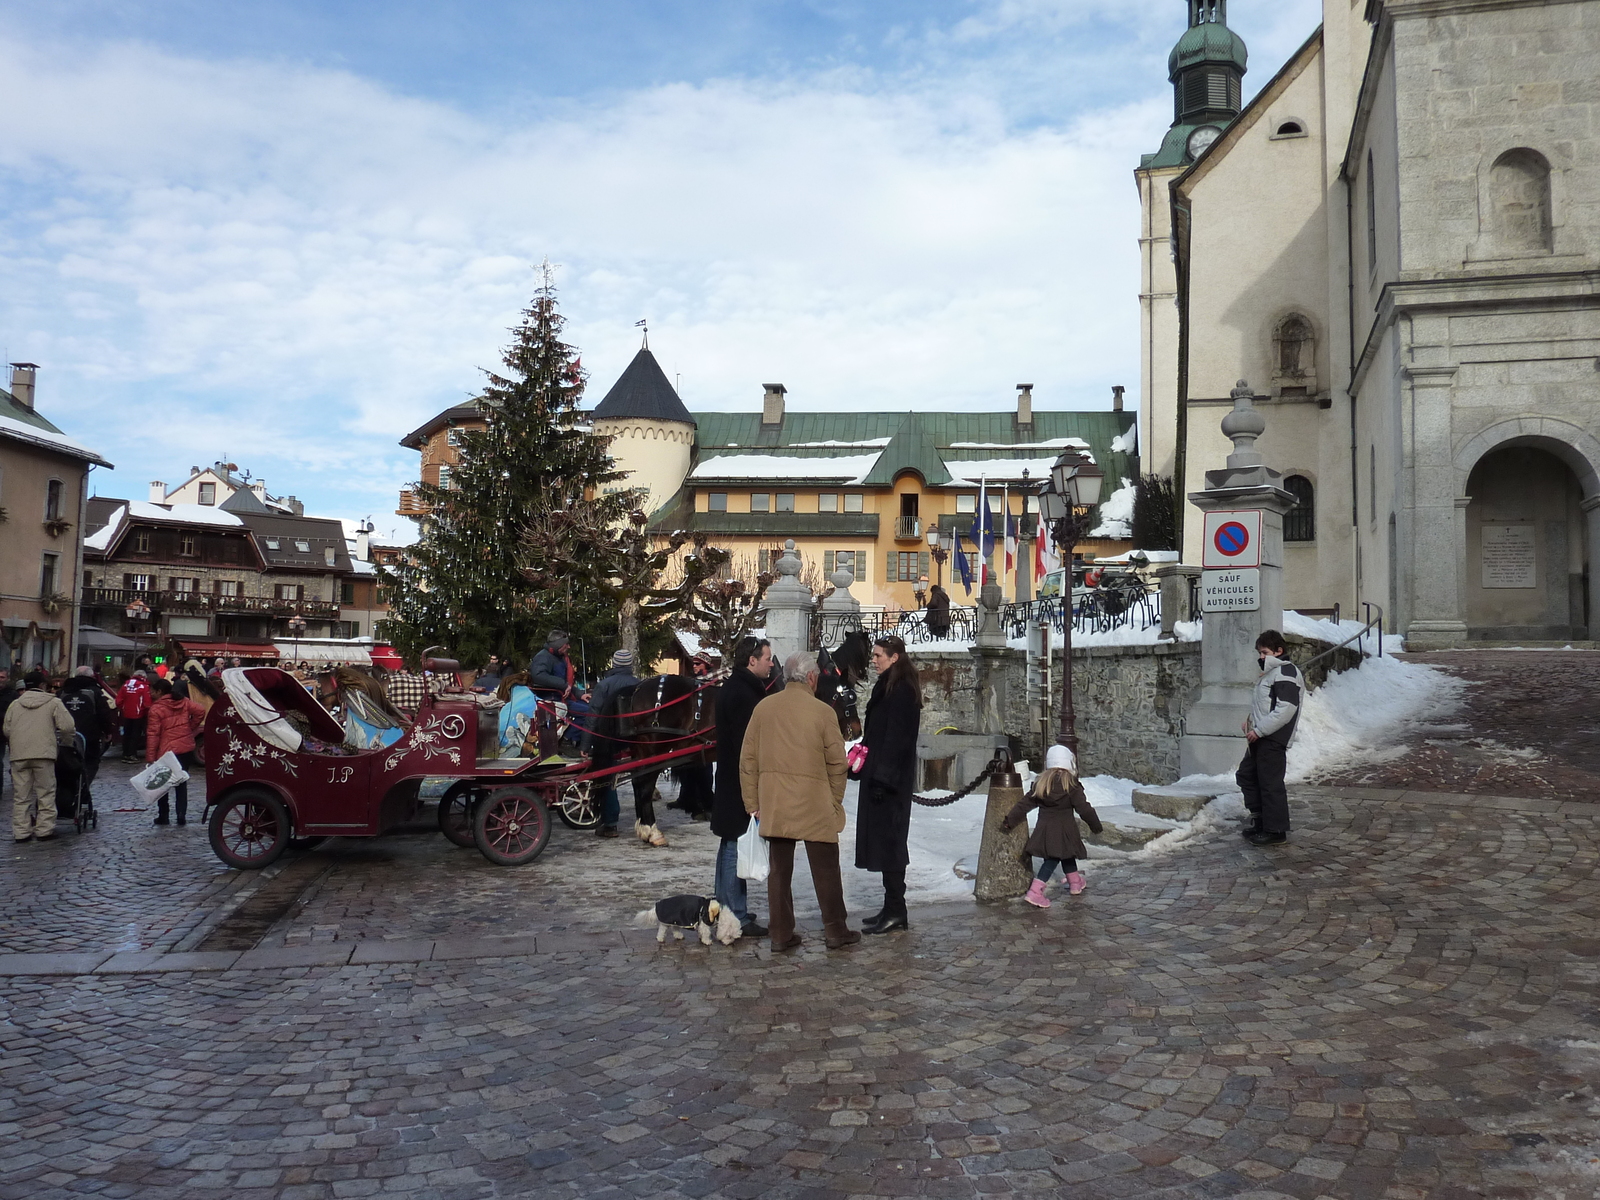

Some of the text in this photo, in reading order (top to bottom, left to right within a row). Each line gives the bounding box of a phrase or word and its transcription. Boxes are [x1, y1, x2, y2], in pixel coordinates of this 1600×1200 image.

[1218, 575, 1241, 583] SAUF
[1206, 586, 1254, 595] VÉHICULES
[1206, 597, 1254, 606] AUTORISÉS
